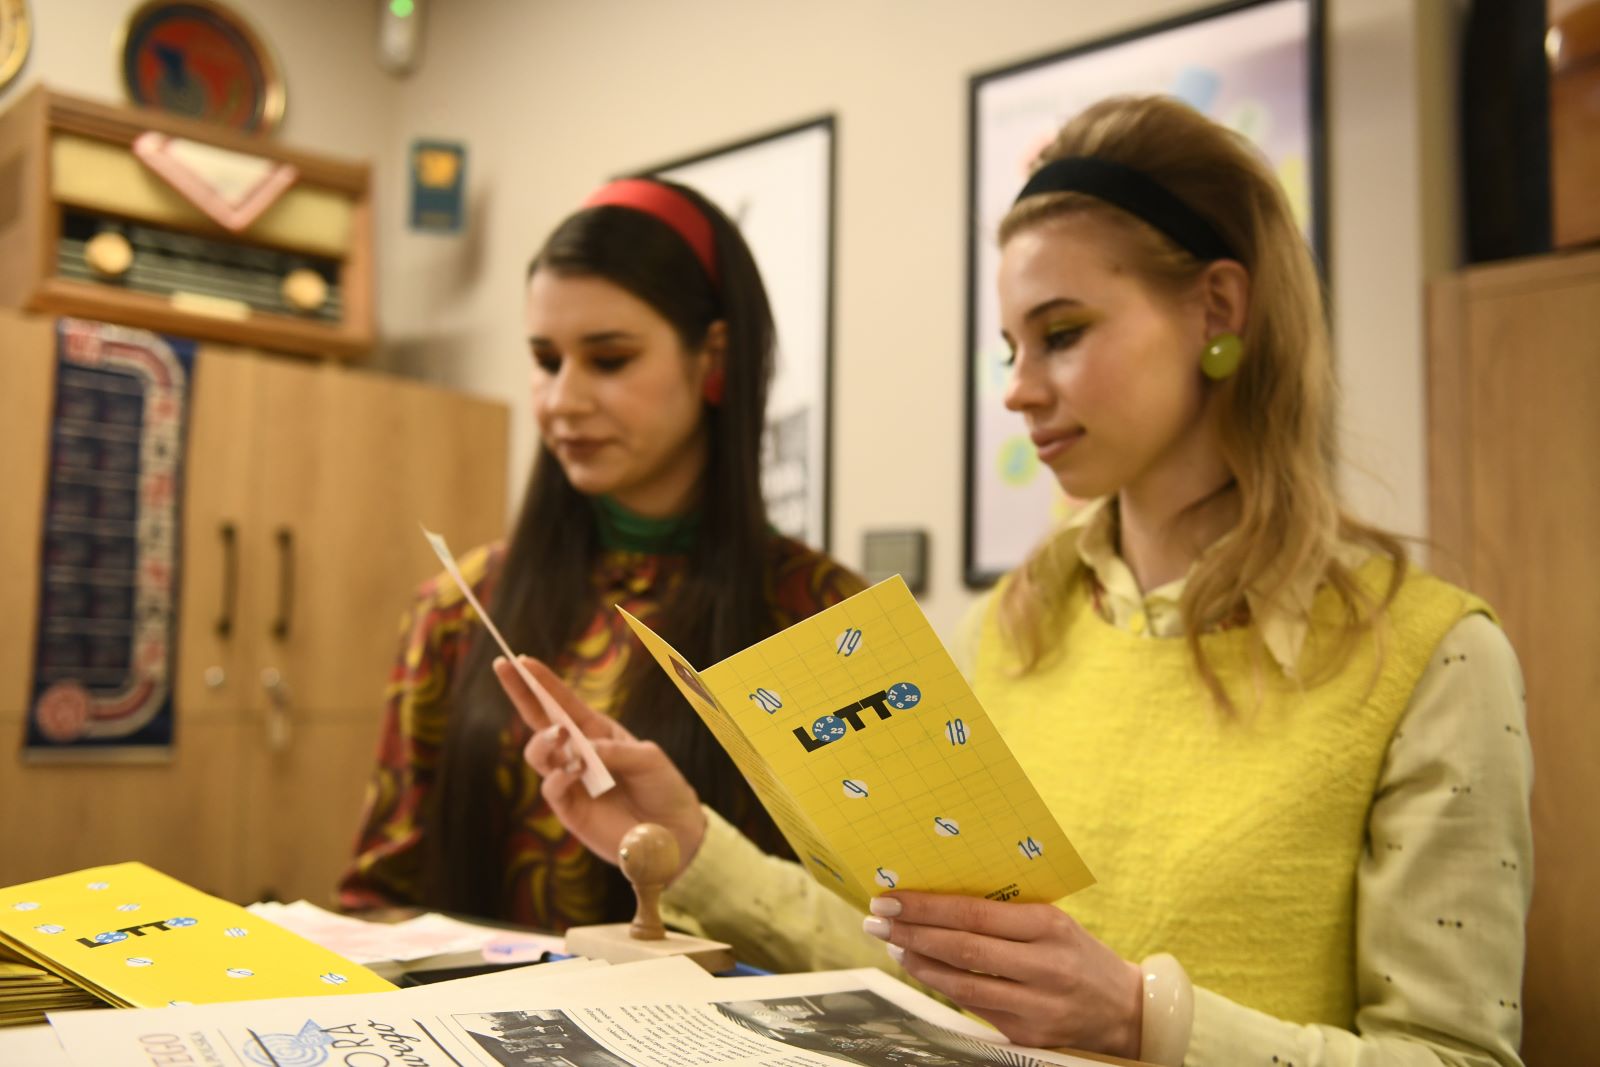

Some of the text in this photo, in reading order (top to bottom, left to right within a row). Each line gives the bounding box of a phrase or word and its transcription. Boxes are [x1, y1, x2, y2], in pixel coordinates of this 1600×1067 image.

[836, 627, 862, 657] 19
[748, 687, 783, 715] 20
[792, 682, 921, 753] LOTTO
[945, 718, 967, 747] 18
[1017, 836, 1043, 861] 14
[876, 866, 896, 889] 5
[75, 917, 198, 949] LOTTO
